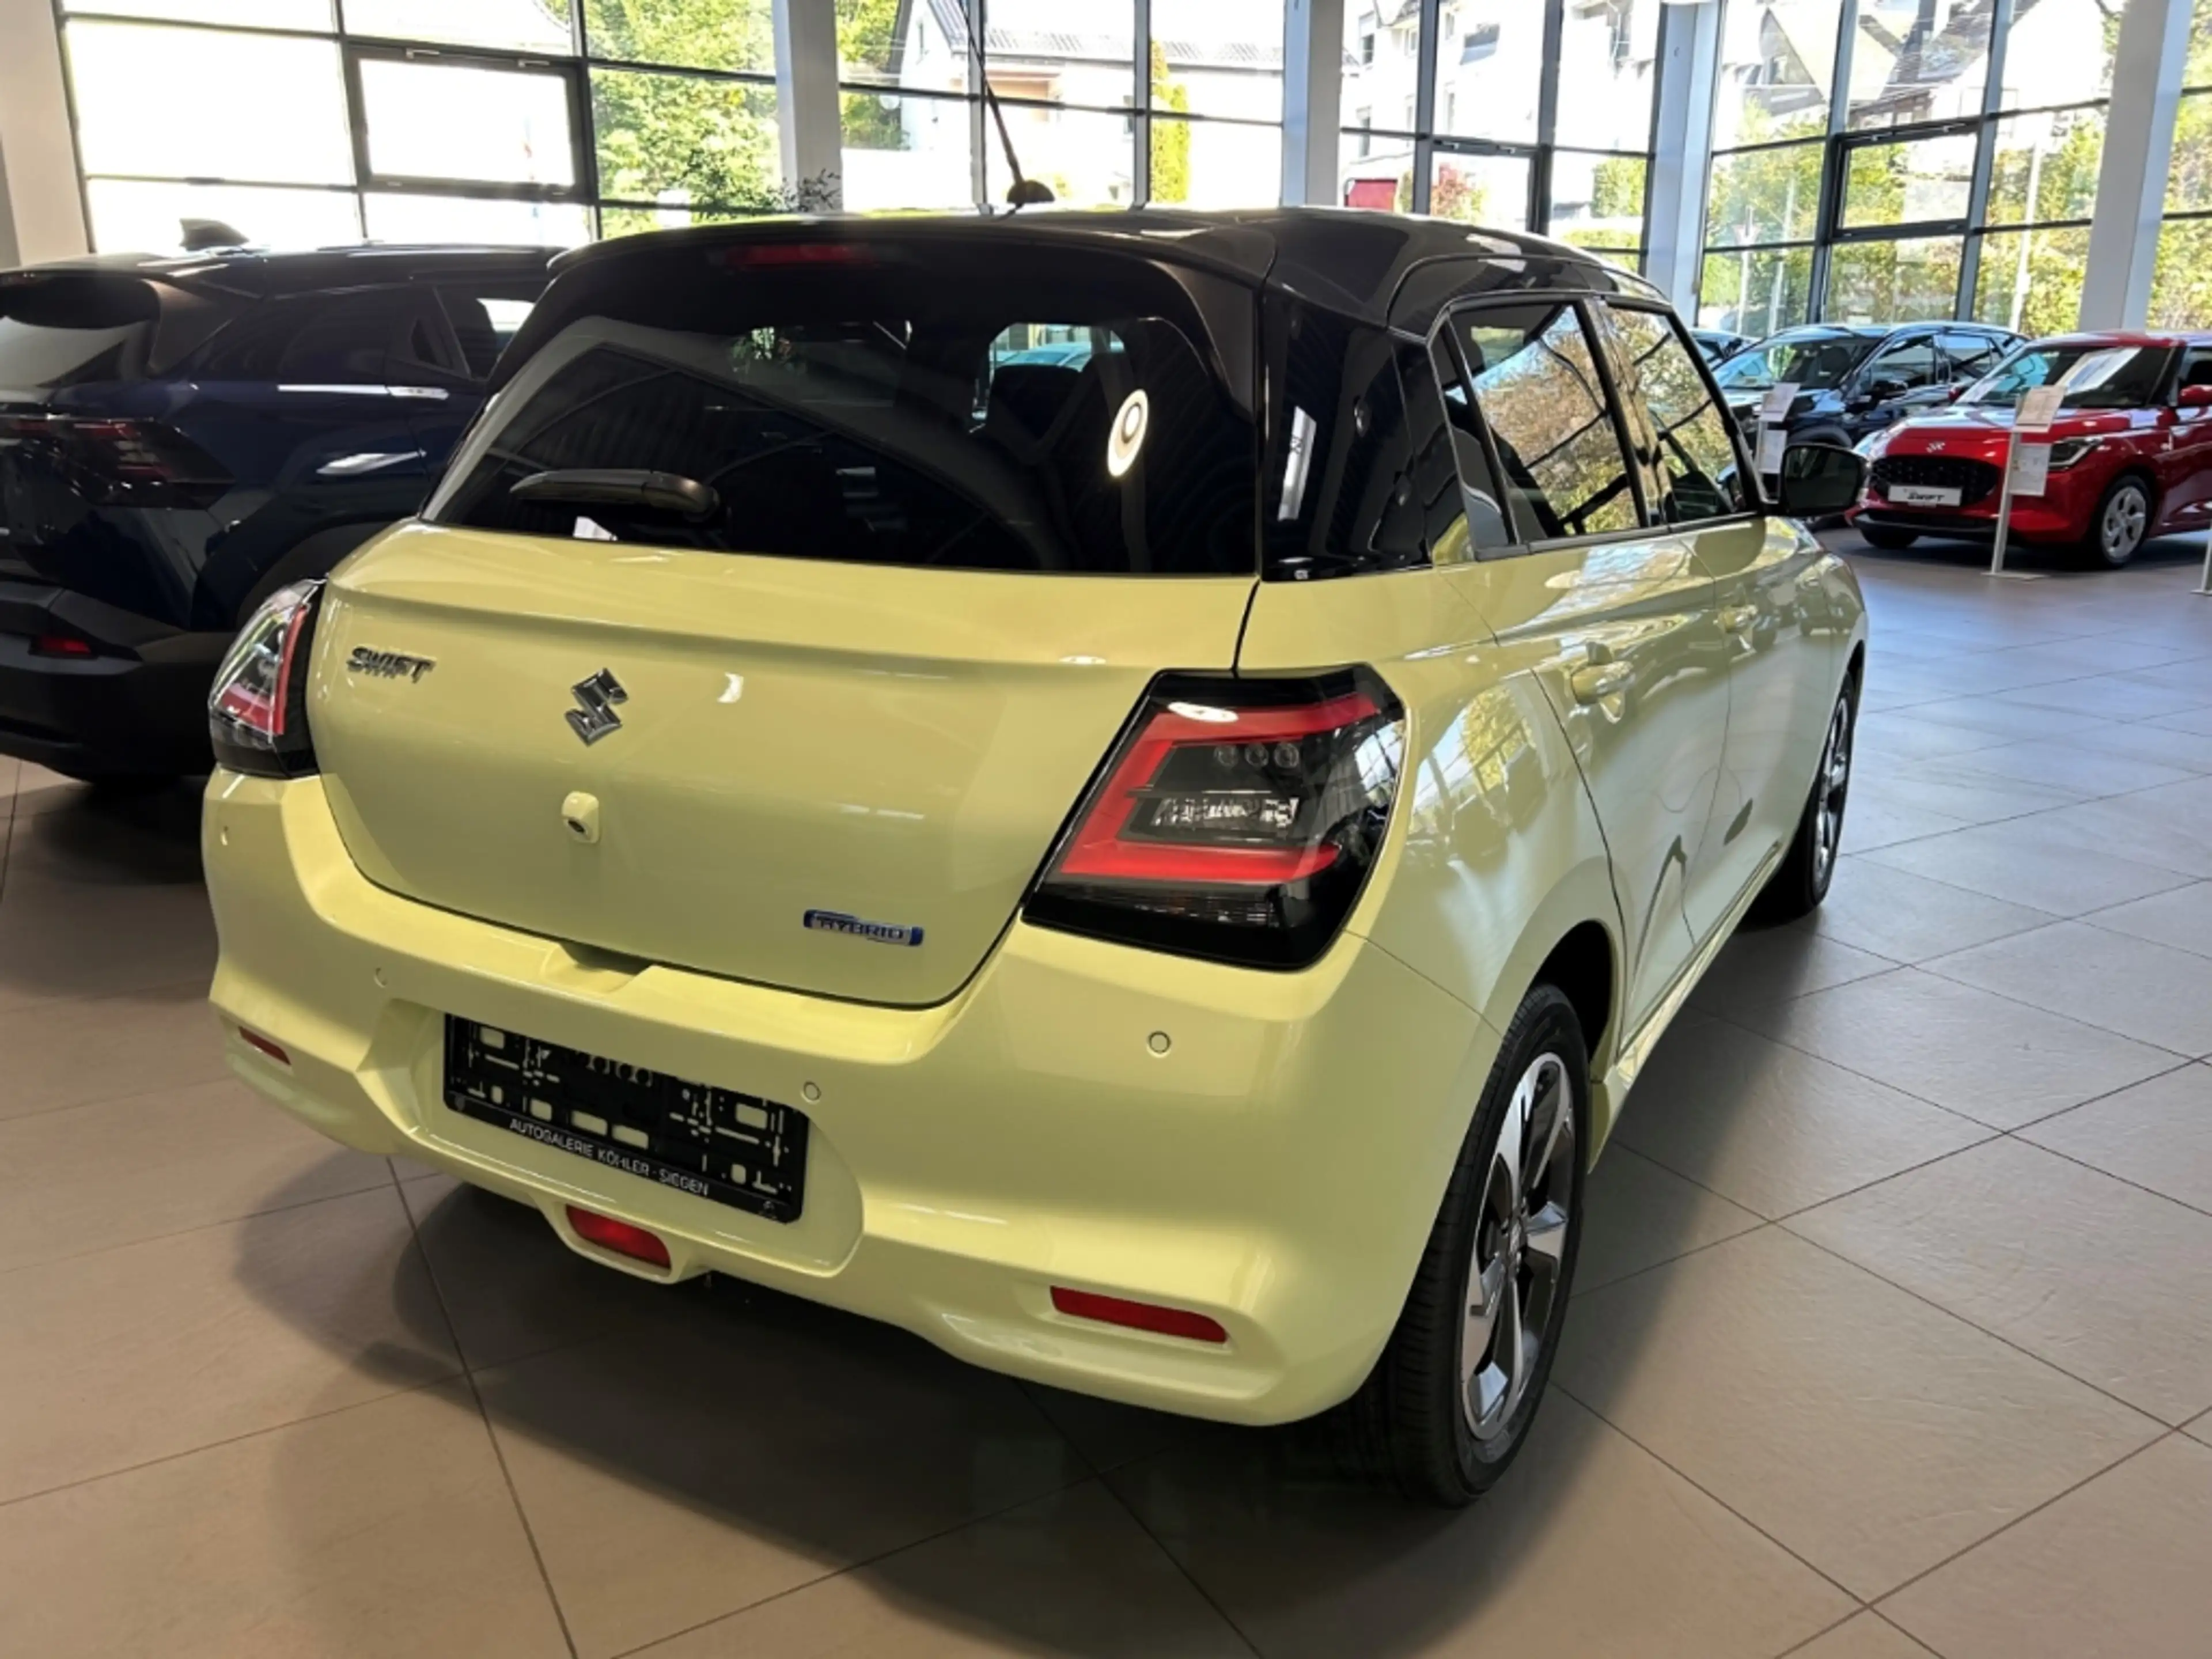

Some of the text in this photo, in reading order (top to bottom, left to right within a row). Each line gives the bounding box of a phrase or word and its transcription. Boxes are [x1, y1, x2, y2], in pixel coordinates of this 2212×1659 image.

[347, 646, 436, 683] SWIFT
[816, 916, 904, 940] HYBRID
[509, 1118, 594, 1158] AUTOGALERIE
[597, 1147, 649, 1176] KÖHLER
[658, 1168, 709, 1196] SIEGEN
